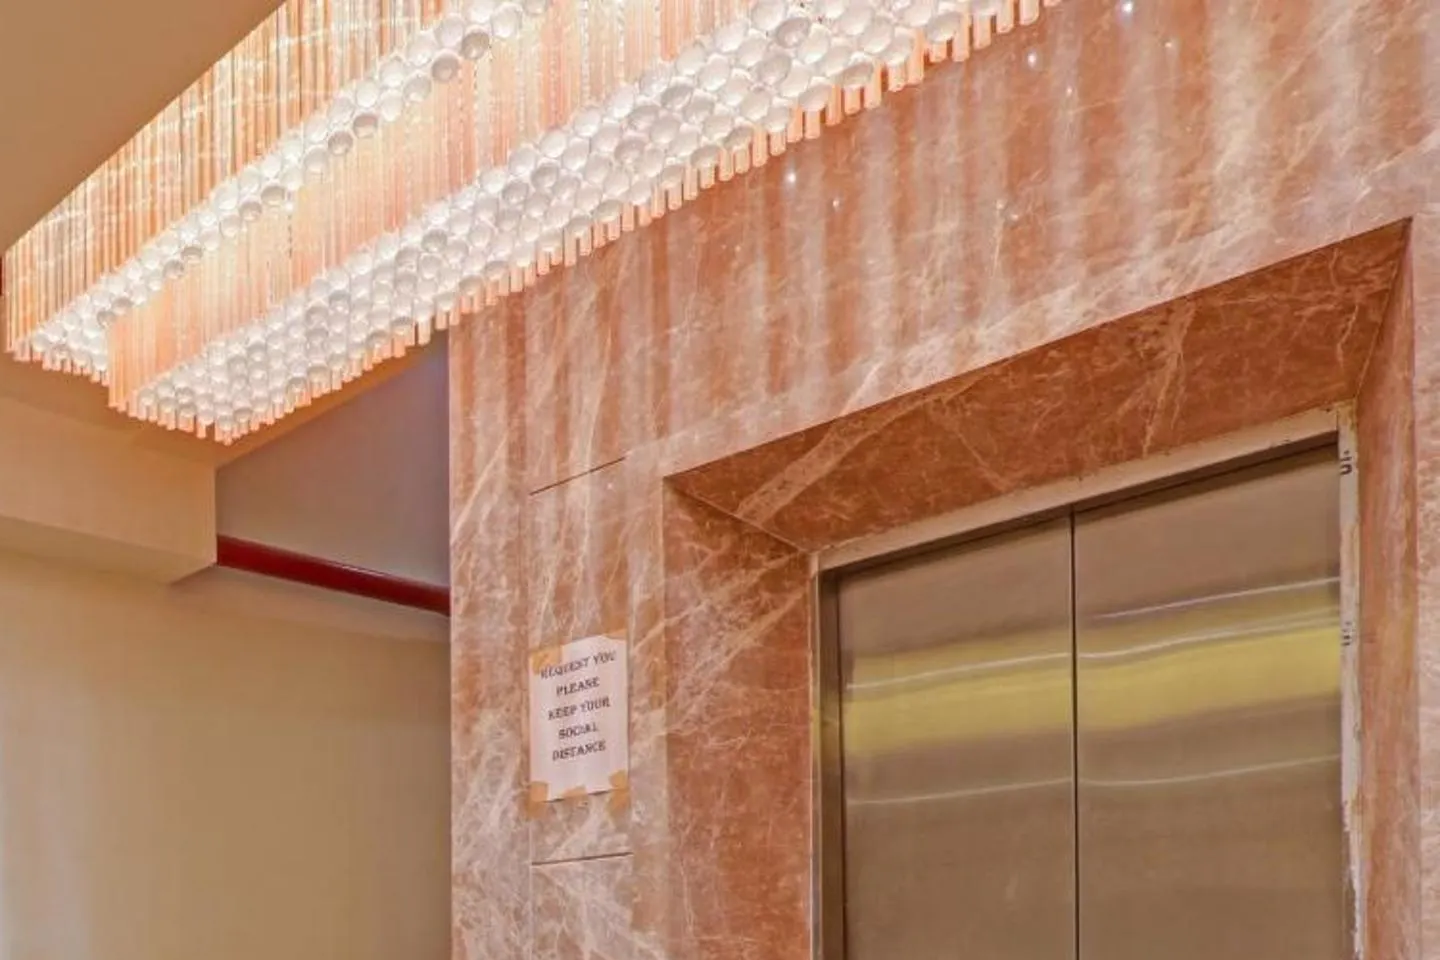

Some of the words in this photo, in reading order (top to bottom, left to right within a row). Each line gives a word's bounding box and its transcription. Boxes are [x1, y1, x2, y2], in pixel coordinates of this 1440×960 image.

[540, 656, 590, 679] REQUEST
[593, 651, 616, 666] YOU
[556, 676, 600, 696] PLEASE
[548, 705, 578, 720] KEEP
[580, 697, 611, 713] YOUR
[559, 722, 598, 739] SOCIAL
[553, 741, 606, 760] DISTANCE
